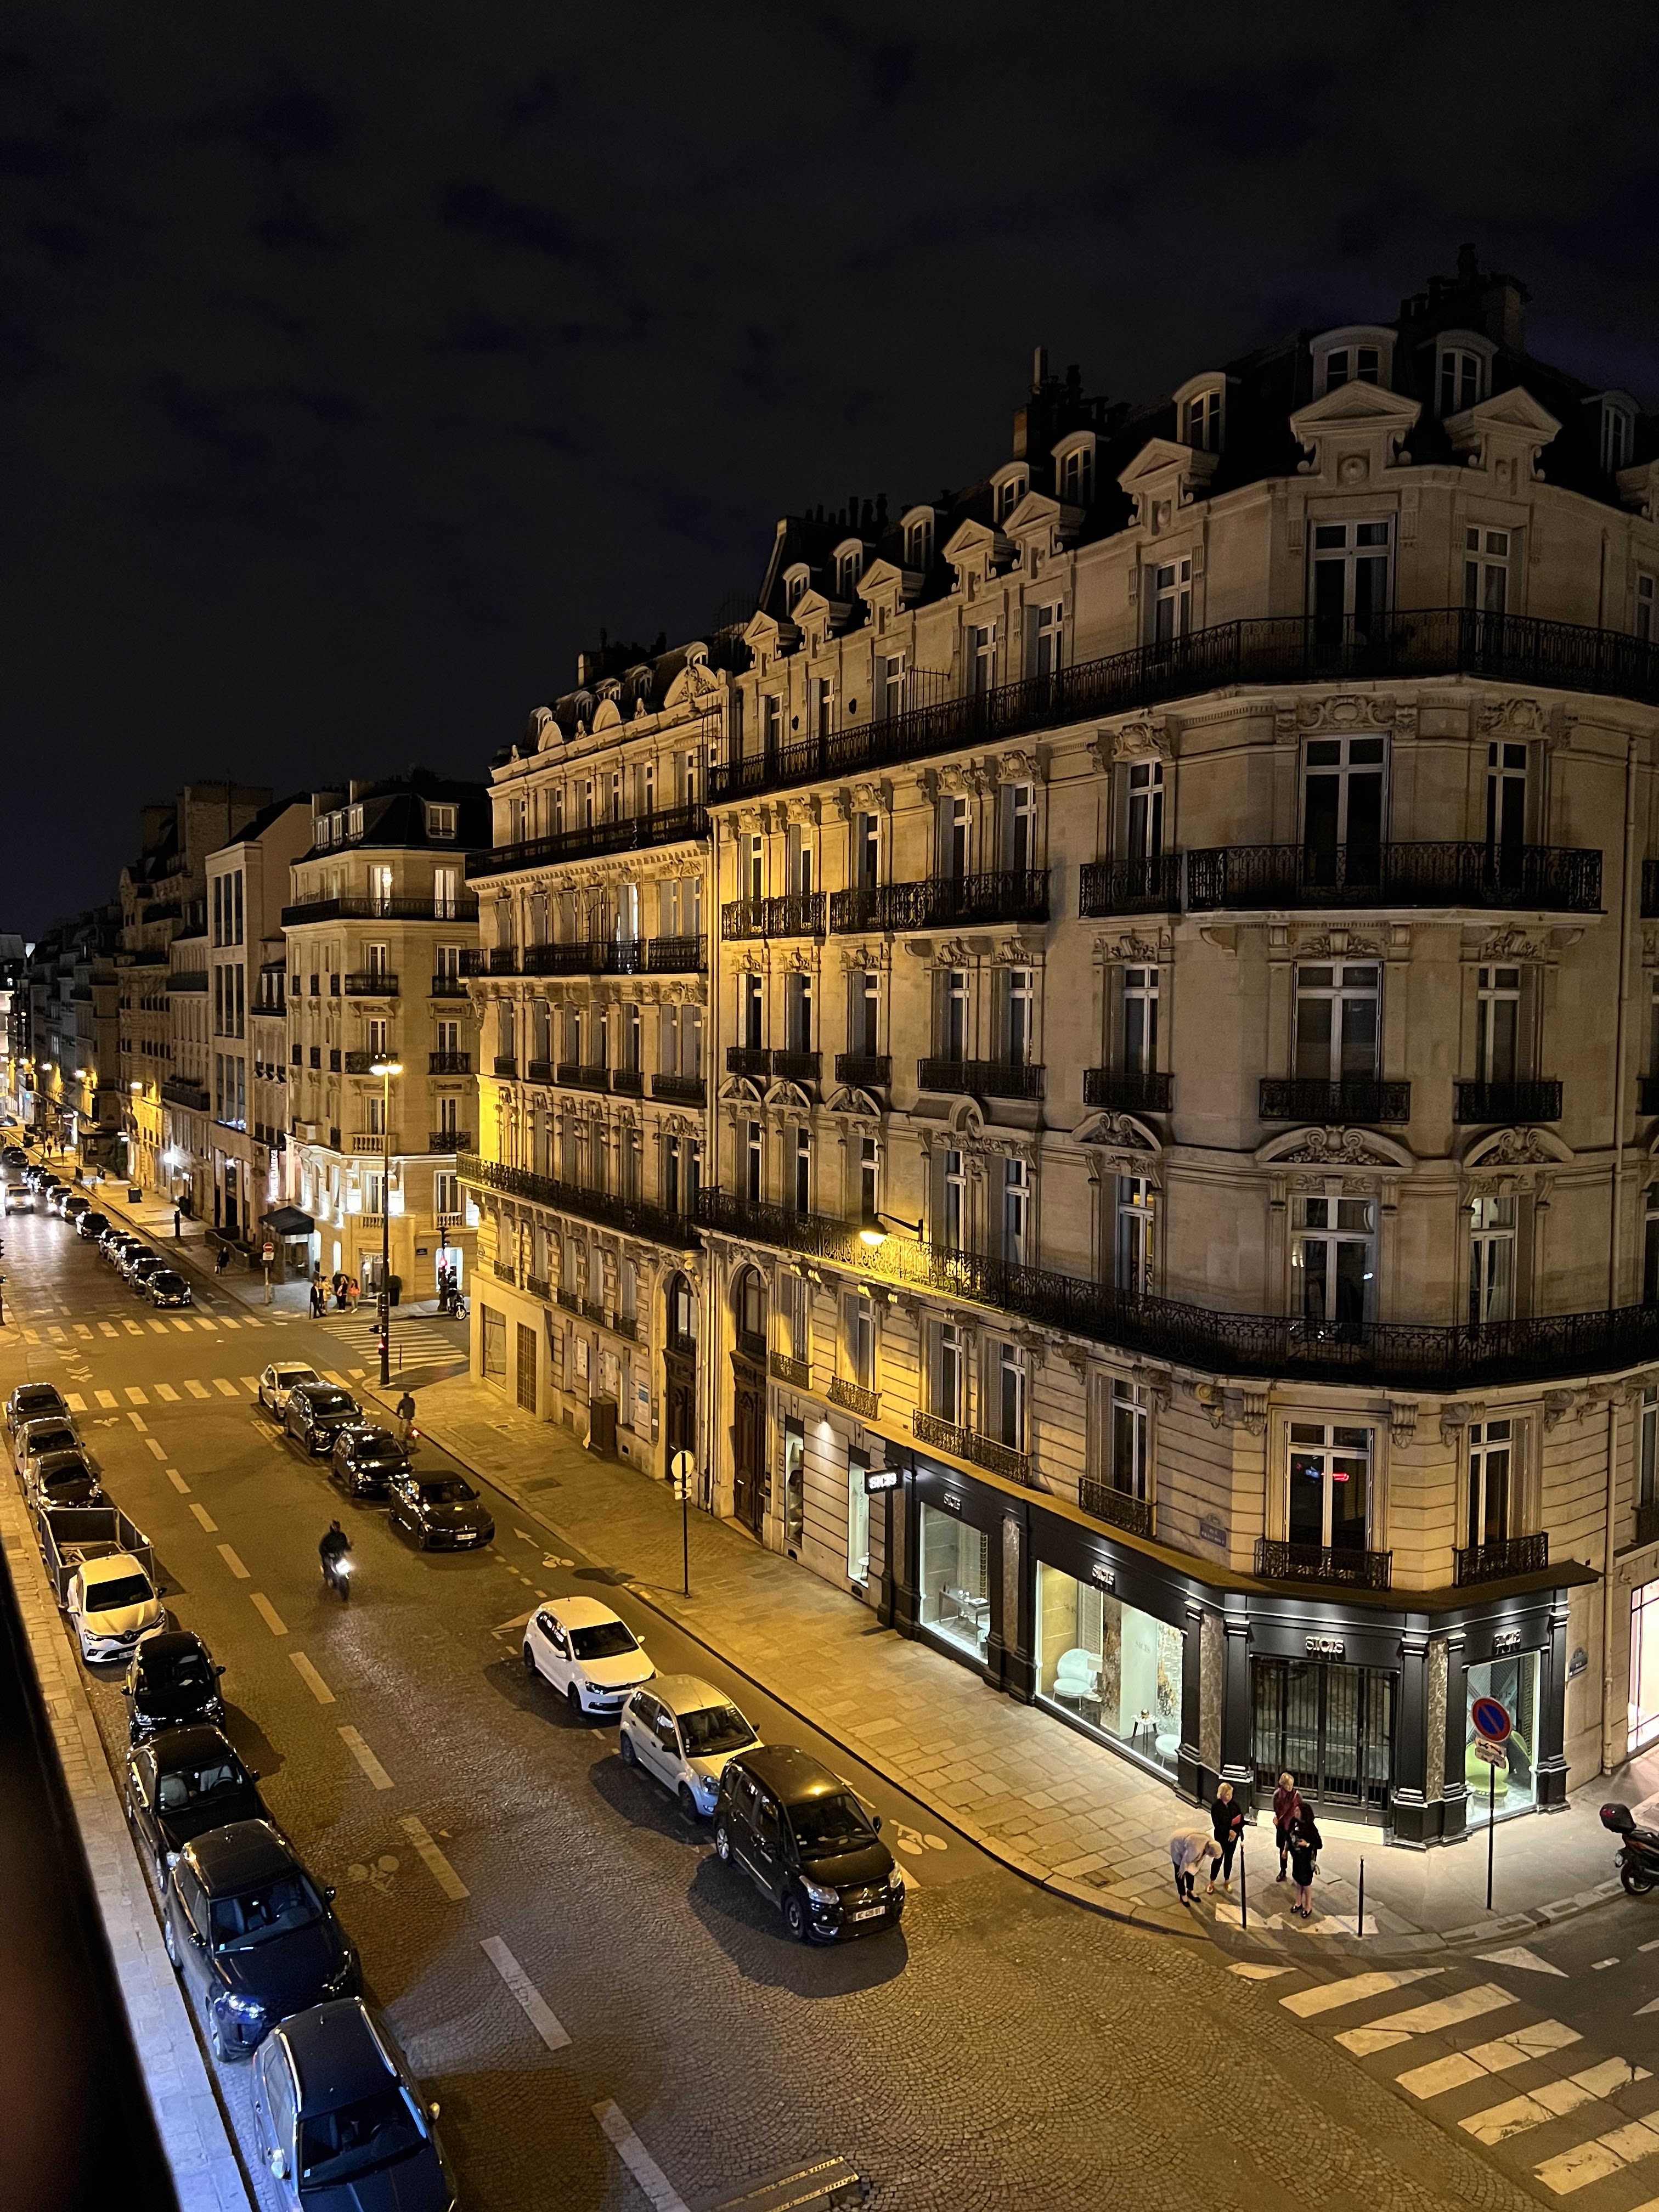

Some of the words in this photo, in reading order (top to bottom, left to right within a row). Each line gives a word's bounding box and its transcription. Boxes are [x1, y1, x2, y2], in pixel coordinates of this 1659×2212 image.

[868, 1472, 897, 1489] SICIS
[944, 1493, 961, 1510] SICIS
[1092, 1565, 1115, 1585] SICIS
[1305, 1636, 1344, 1654] SICIS
